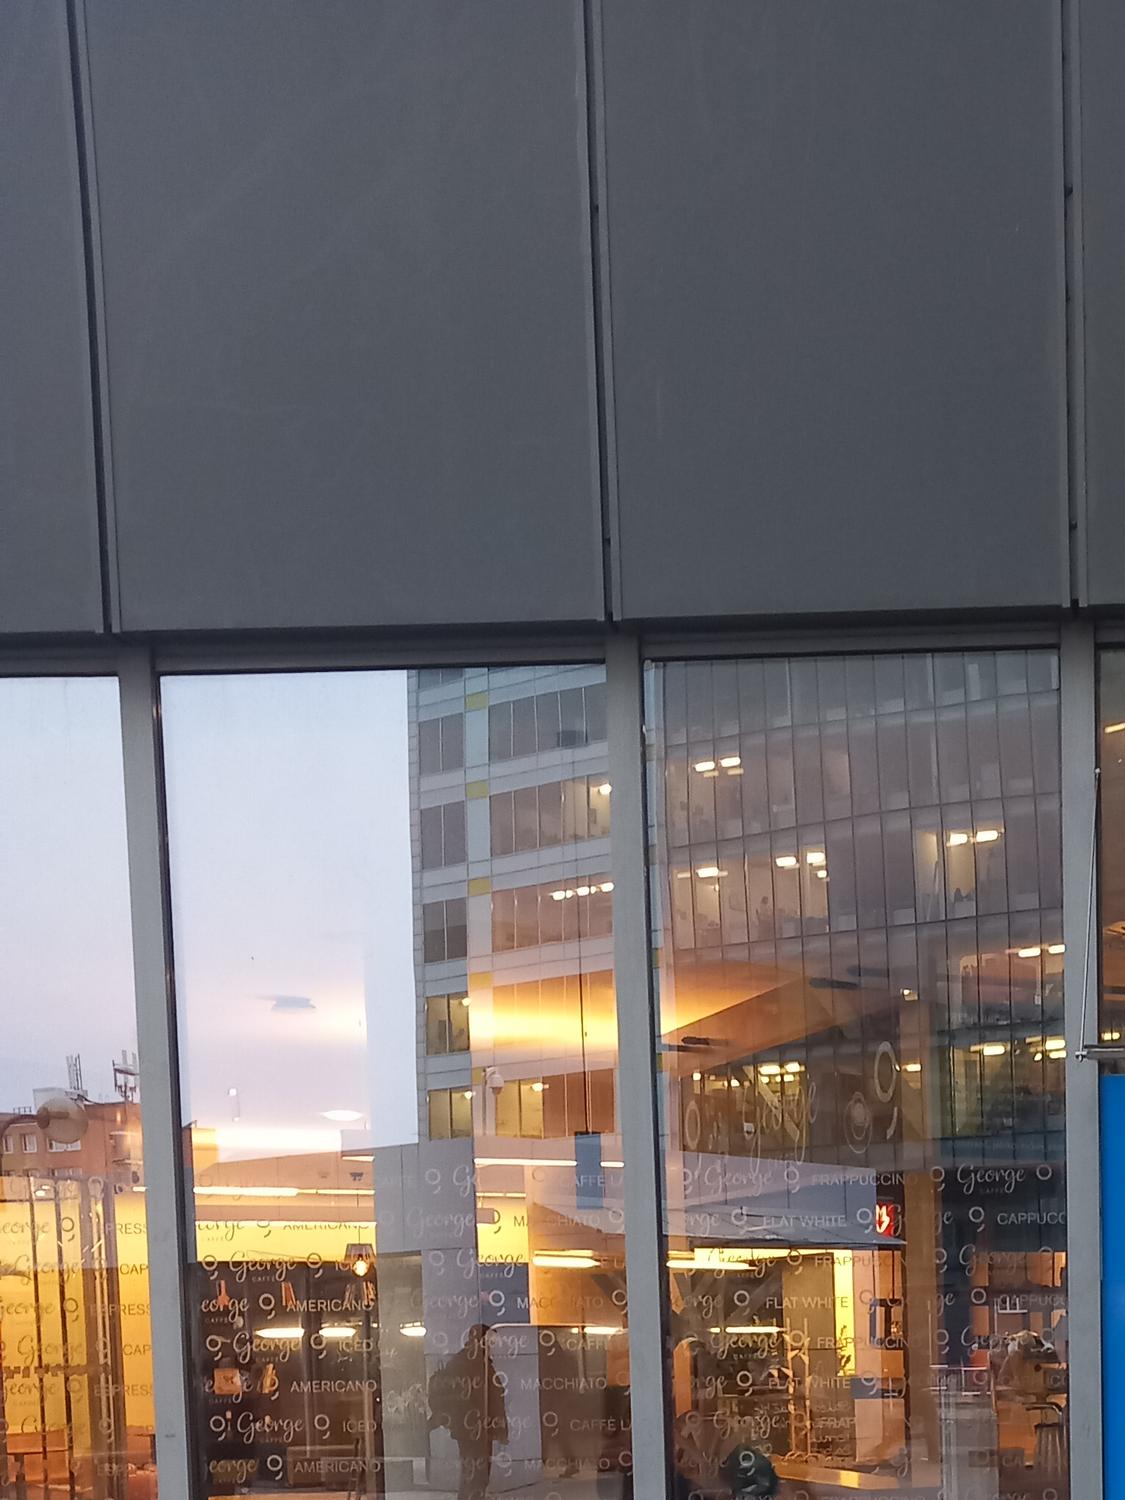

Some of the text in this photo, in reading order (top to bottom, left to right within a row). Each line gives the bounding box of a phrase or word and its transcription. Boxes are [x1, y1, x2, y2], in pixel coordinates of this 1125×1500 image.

[957, 1163, 1026, 1195] George
[799, 1214, 846, 1227] WHITE
[229, 1250, 296, 1284] George
[457, 1248, 523, 1280] George
[286, 1299, 375, 1312] AMERICANO
[766, 1297, 798, 1309] FLAT
[803, 1296, 849, 1309] WHITE
[233, 1331, 300, 1364] George
[339, 1340, 373, 1352] ICED
[461, 1328, 529, 1360] George
[710, 1328, 780, 1360] George
[290, 1380, 377, 1393] AMERICANO
[520, 1377, 607, 1390] MACCHIATO
[237, 1411, 304, 1445] George
[342, 1420, 377, 1433] ICED
[463, 1408, 531, 1441] George
[294, 1461, 381, 1473] AMERICANO
[524, 1459, 610, 1472] MACCHIAO
